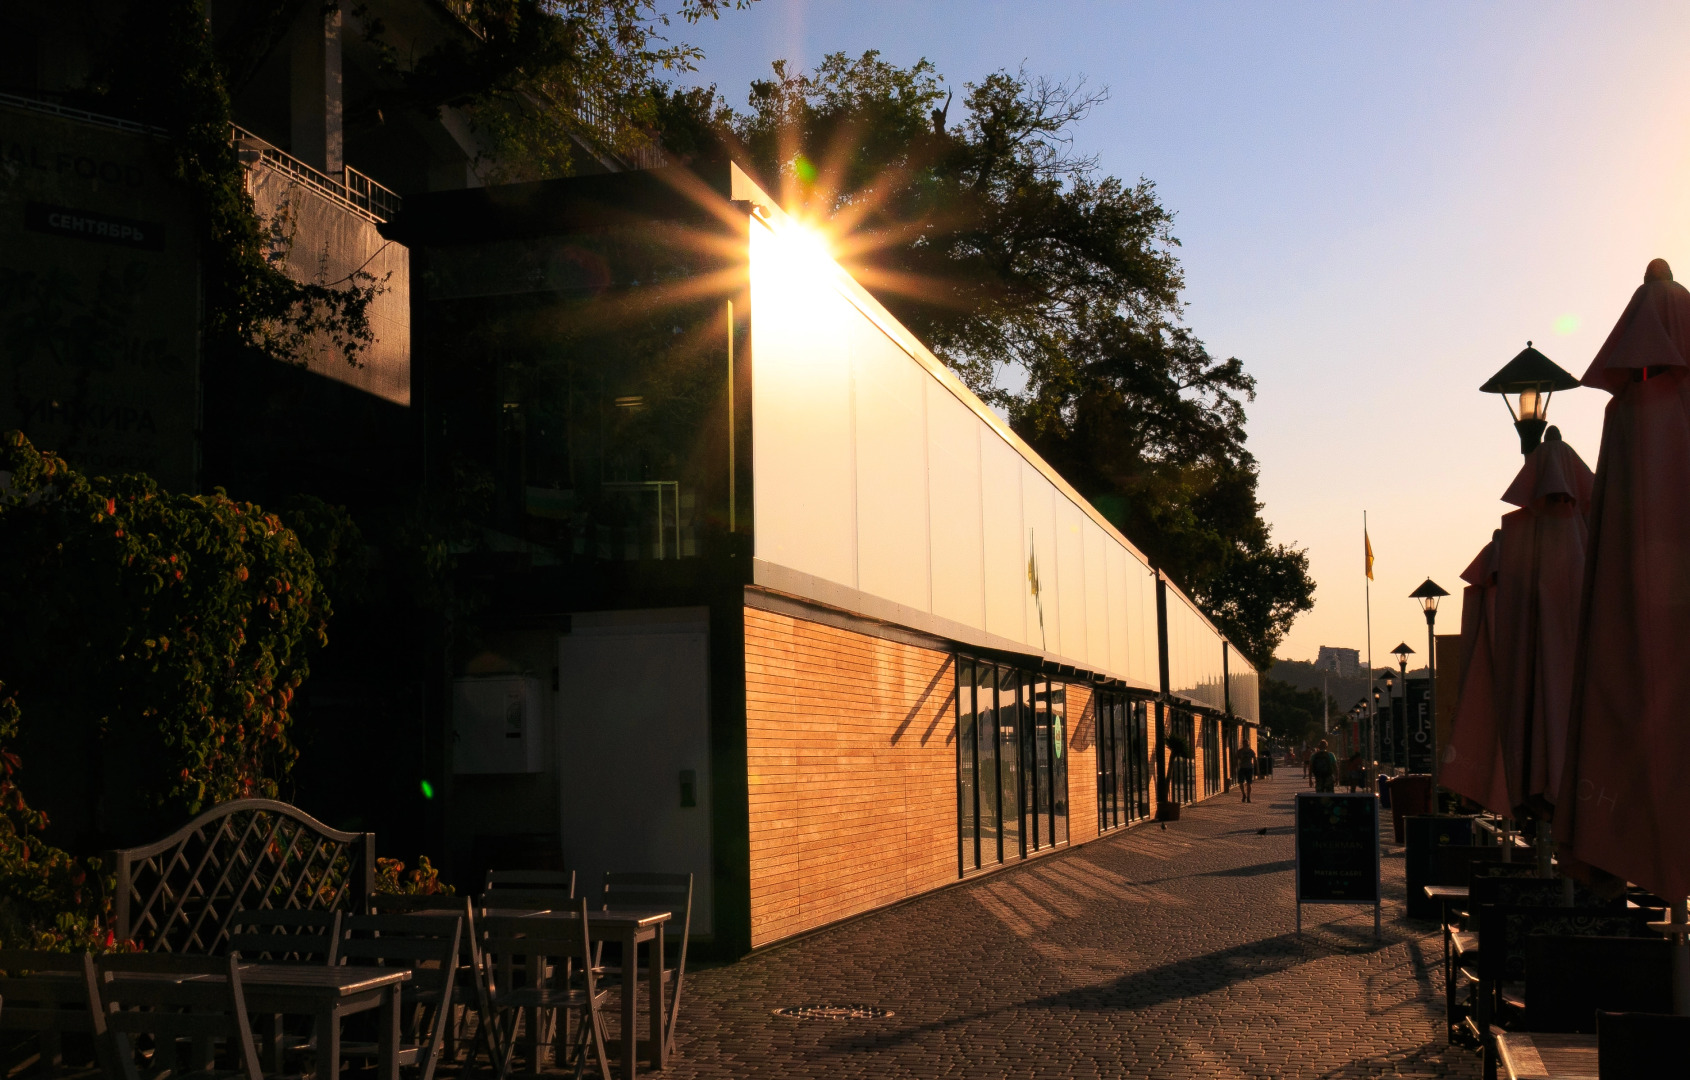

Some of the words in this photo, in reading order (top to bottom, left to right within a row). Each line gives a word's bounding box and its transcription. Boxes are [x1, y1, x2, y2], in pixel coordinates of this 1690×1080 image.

[0, 138, 47, 171] AL
[57, 152, 143, 188] FOOD
[48, 212, 145, 242] СЕНТЯБРЬ
[26, 397, 157, 434] ИНЖИРА
